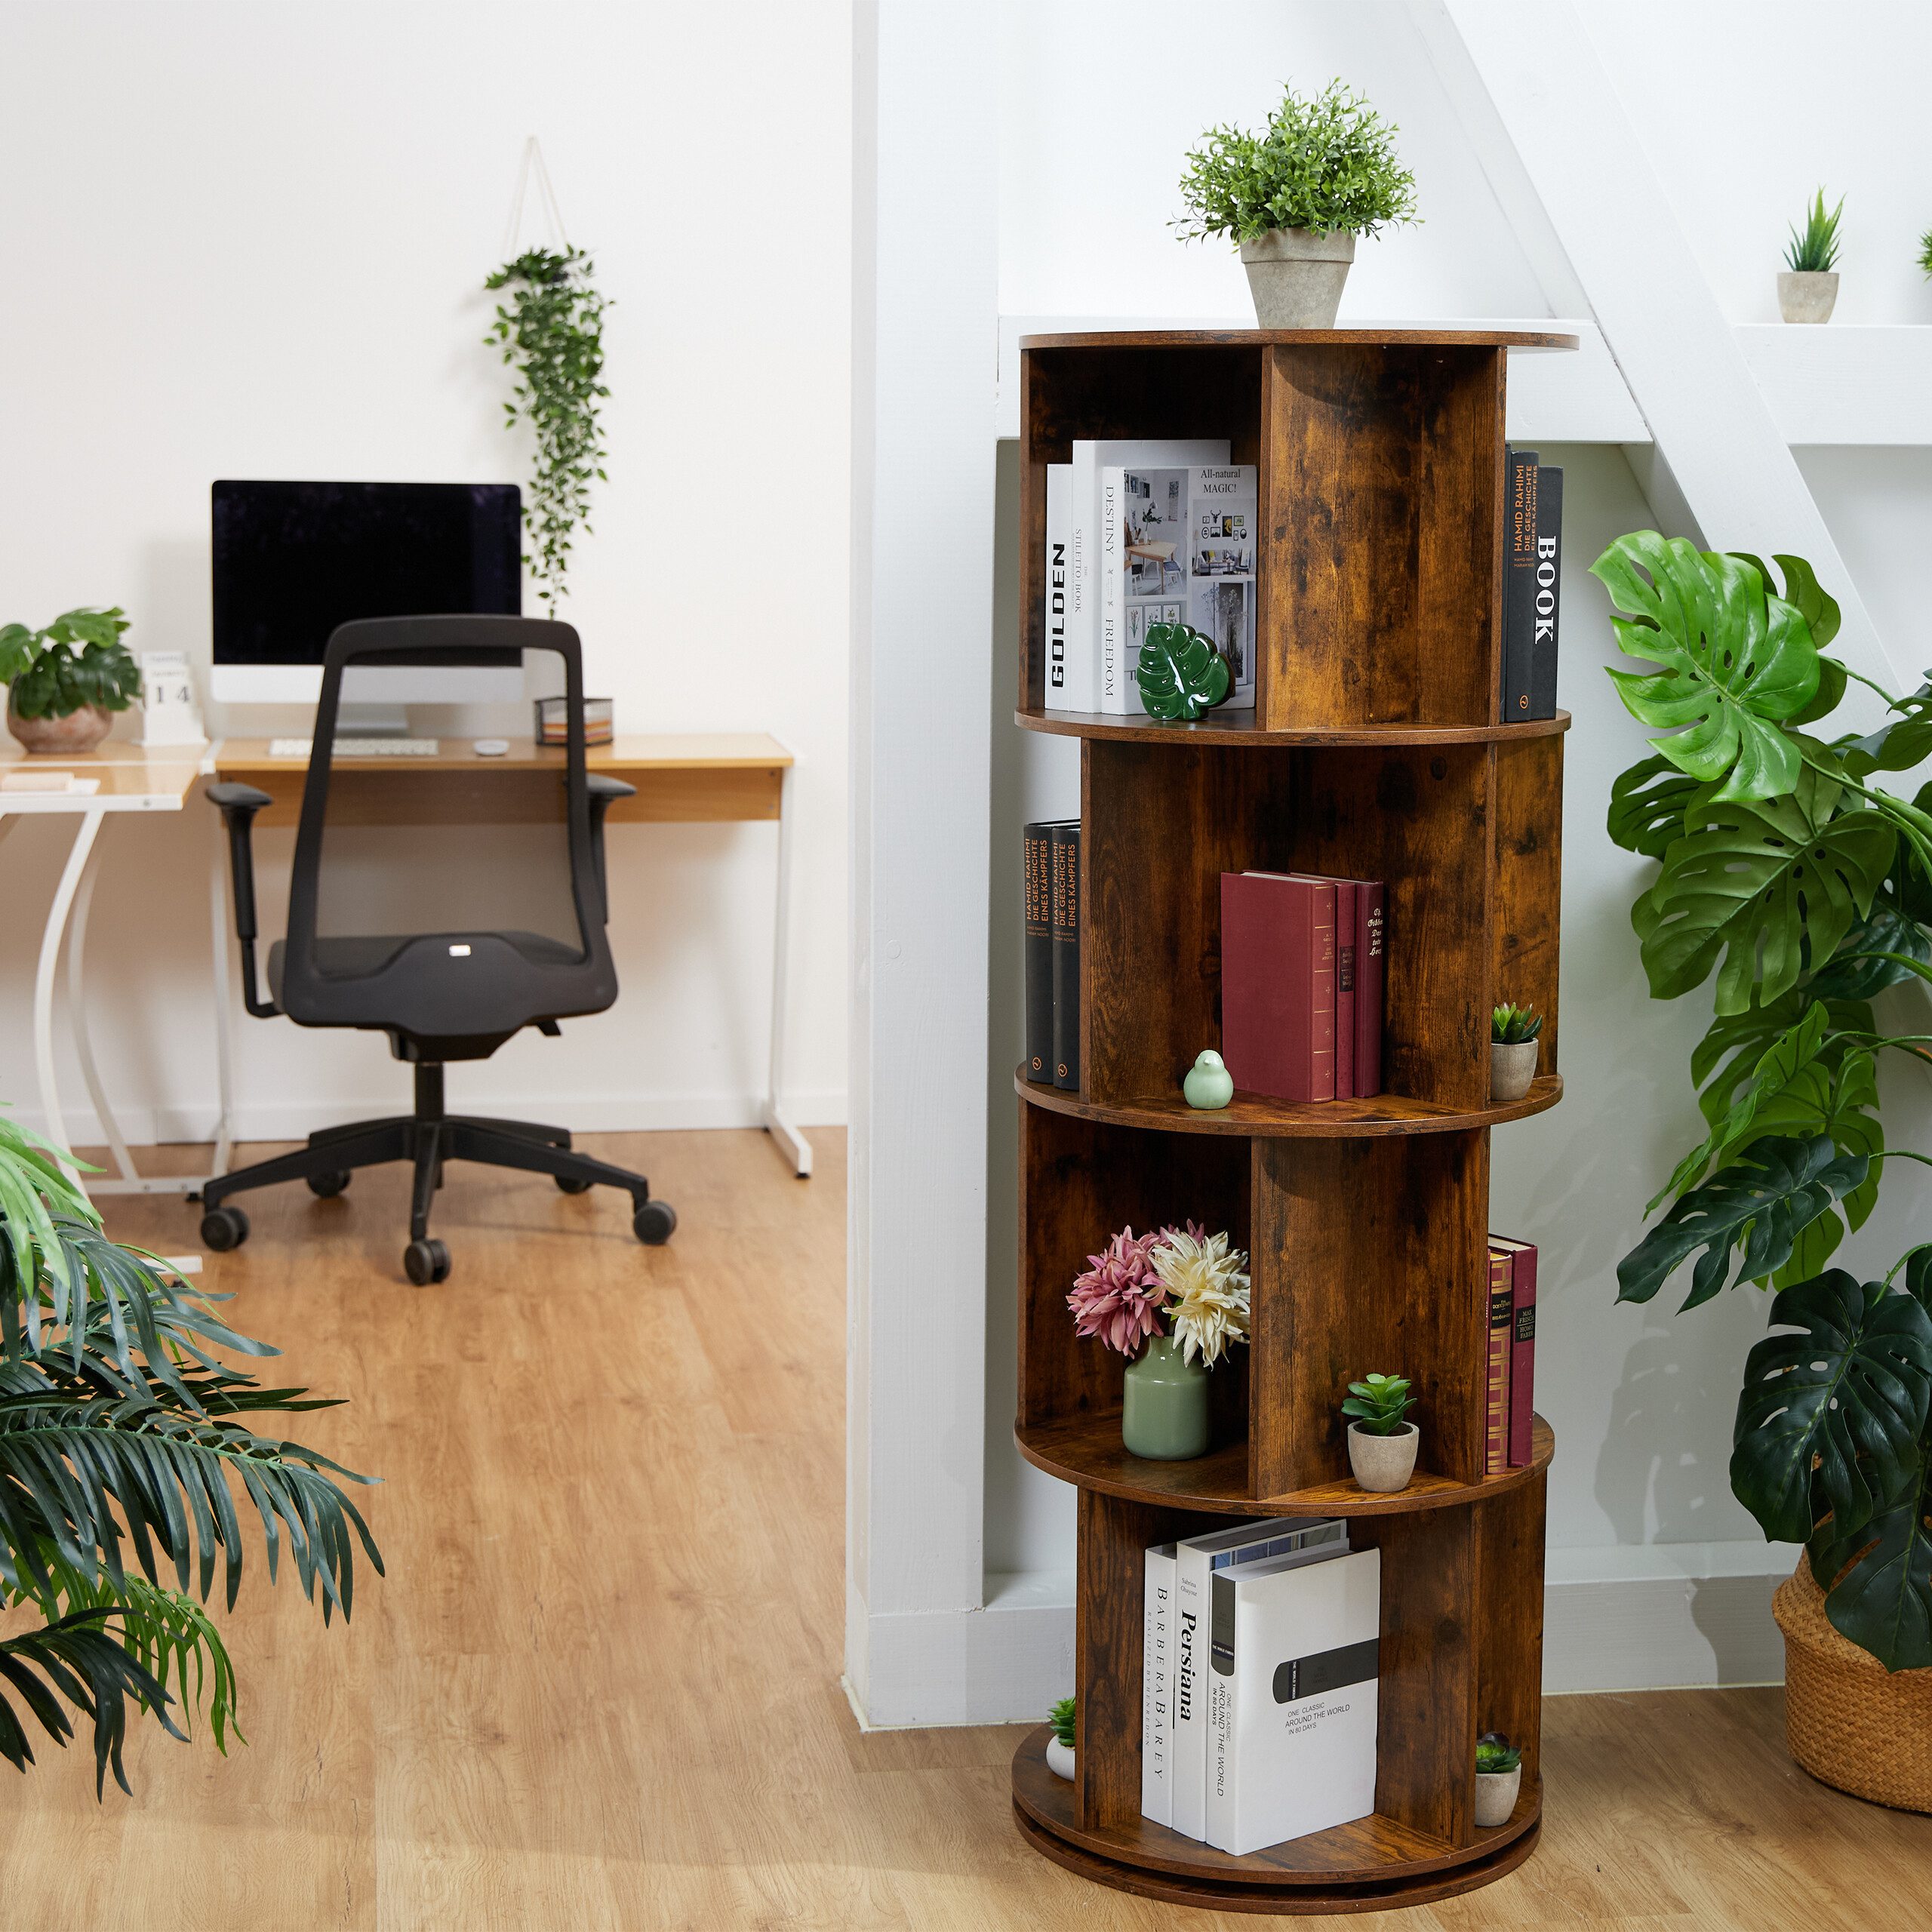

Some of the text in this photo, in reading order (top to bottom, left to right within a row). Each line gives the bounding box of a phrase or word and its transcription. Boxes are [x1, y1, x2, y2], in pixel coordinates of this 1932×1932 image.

[1200, 468, 1241, 479] All-natural
[1203, 483, 1237, 494] MAGIC!
[1105, 486, 1115, 555] DESTINY
[1514, 465, 1524, 552] HAMID RAHIMI
[1051, 543, 1065, 688] GOLDEN
[1534, 535, 1556, 645] BOOK
[1106, 619, 1115, 697] FREEDOM
[1040, 840, 1048, 891] KÄMPFERS
[1067, 844, 1076, 927] EINES KÄMPFERS
[1180, 1609, 1197, 1721] Persiana
[1212, 1697, 1217, 1705] 80
[1284, 1704, 1350, 1728] AROUND THE WORLD
[1287, 1702, 1325, 1718] ONE CLASSIC
[1302, 1722, 1317, 1730] DAYS
